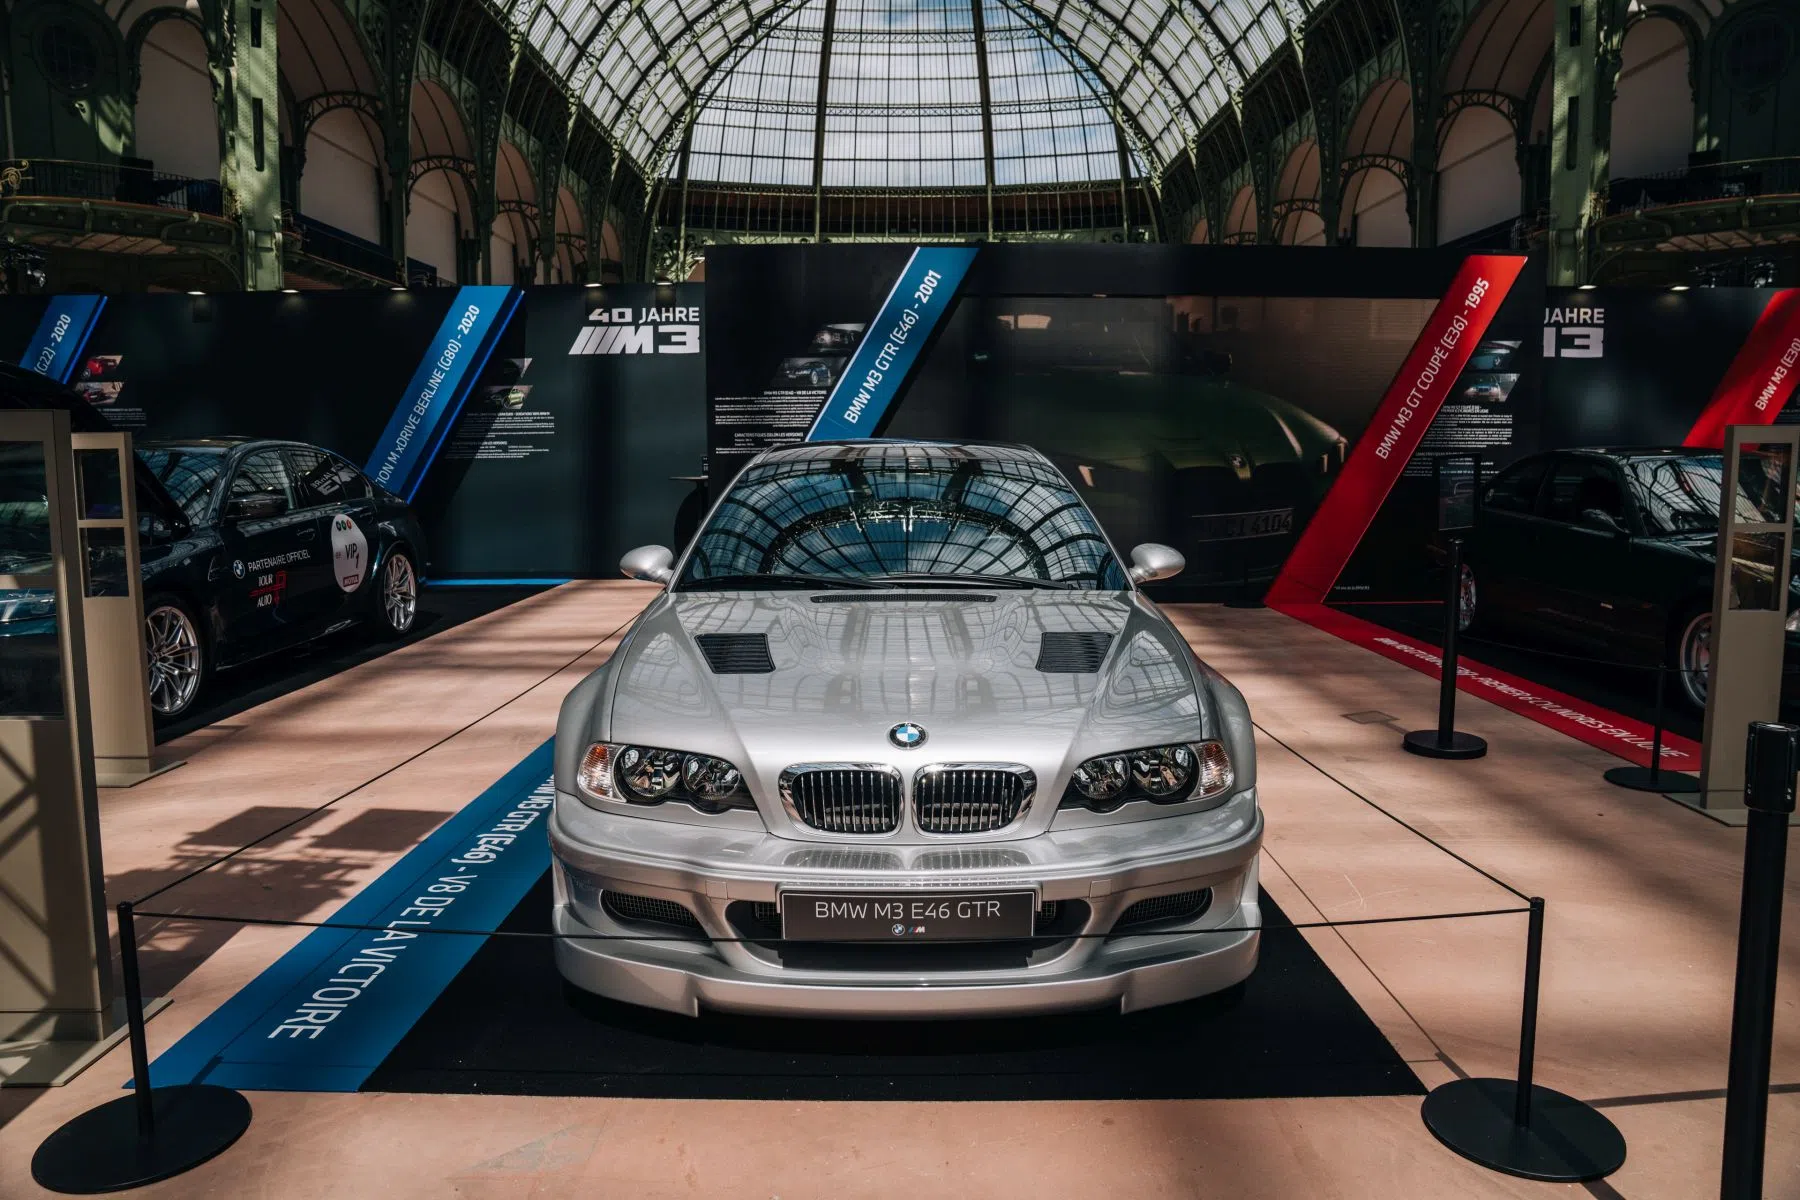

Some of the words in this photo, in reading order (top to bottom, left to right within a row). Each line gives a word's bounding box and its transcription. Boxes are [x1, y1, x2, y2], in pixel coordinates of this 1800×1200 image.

[588, 307, 633, 323] 40
[639, 306, 700, 324] JAHRE
[1543, 307, 1605, 325] JAHRE
[33, 346, 56, 375] (G22)
[50, 313, 71, 343] 2020
[844, 388, 871, 424] BMW
[862, 370, 883, 392] M3
[875, 342, 900, 371] GTR
[889, 309, 919, 345] (E46)
[914, 269, 942, 304] 2001
[1543, 326, 1604, 358] 3
[1376, 425, 1401, 459] BMW
[1394, 406, 1413, 429] M3
[1406, 387, 1424, 408] GT
[1417, 346, 1449, 391] COUPÉ
[1440, 315, 1469, 350] (E36)
[1465, 277, 1490, 309] 1995
[375, 462, 394, 484] ION
[387, 451, 401, 464] M
[396, 414, 421, 455] xDRIVE
[413, 370, 446, 416] BERLINE
[438, 339, 462, 371] (G80)
[457, 304, 480, 335] 2020
[1754, 381, 1777, 411] BMW
[1770, 365, 1788, 385] M3
[247, 554, 286, 573] PARTENAIRE
[285, 548, 311, 564] OFFICIEL
[345, 542, 358, 560] VIP
[258, 573, 274, 587] TOUR
[257, 593, 272, 608] AUTO
[491, 810, 541, 832] GTR
[450, 833, 517, 864] (E46)
[427, 874, 478, 893] V8
[400, 896, 456, 917] DE
[815, 902, 868, 919] BMW
[874, 902, 904, 919] M3
[911, 902, 950, 919] E46
[957, 900, 1001, 918] GTR
[372, 920, 432, 942] LA
[267, 945, 407, 1040] VICTOIRE
